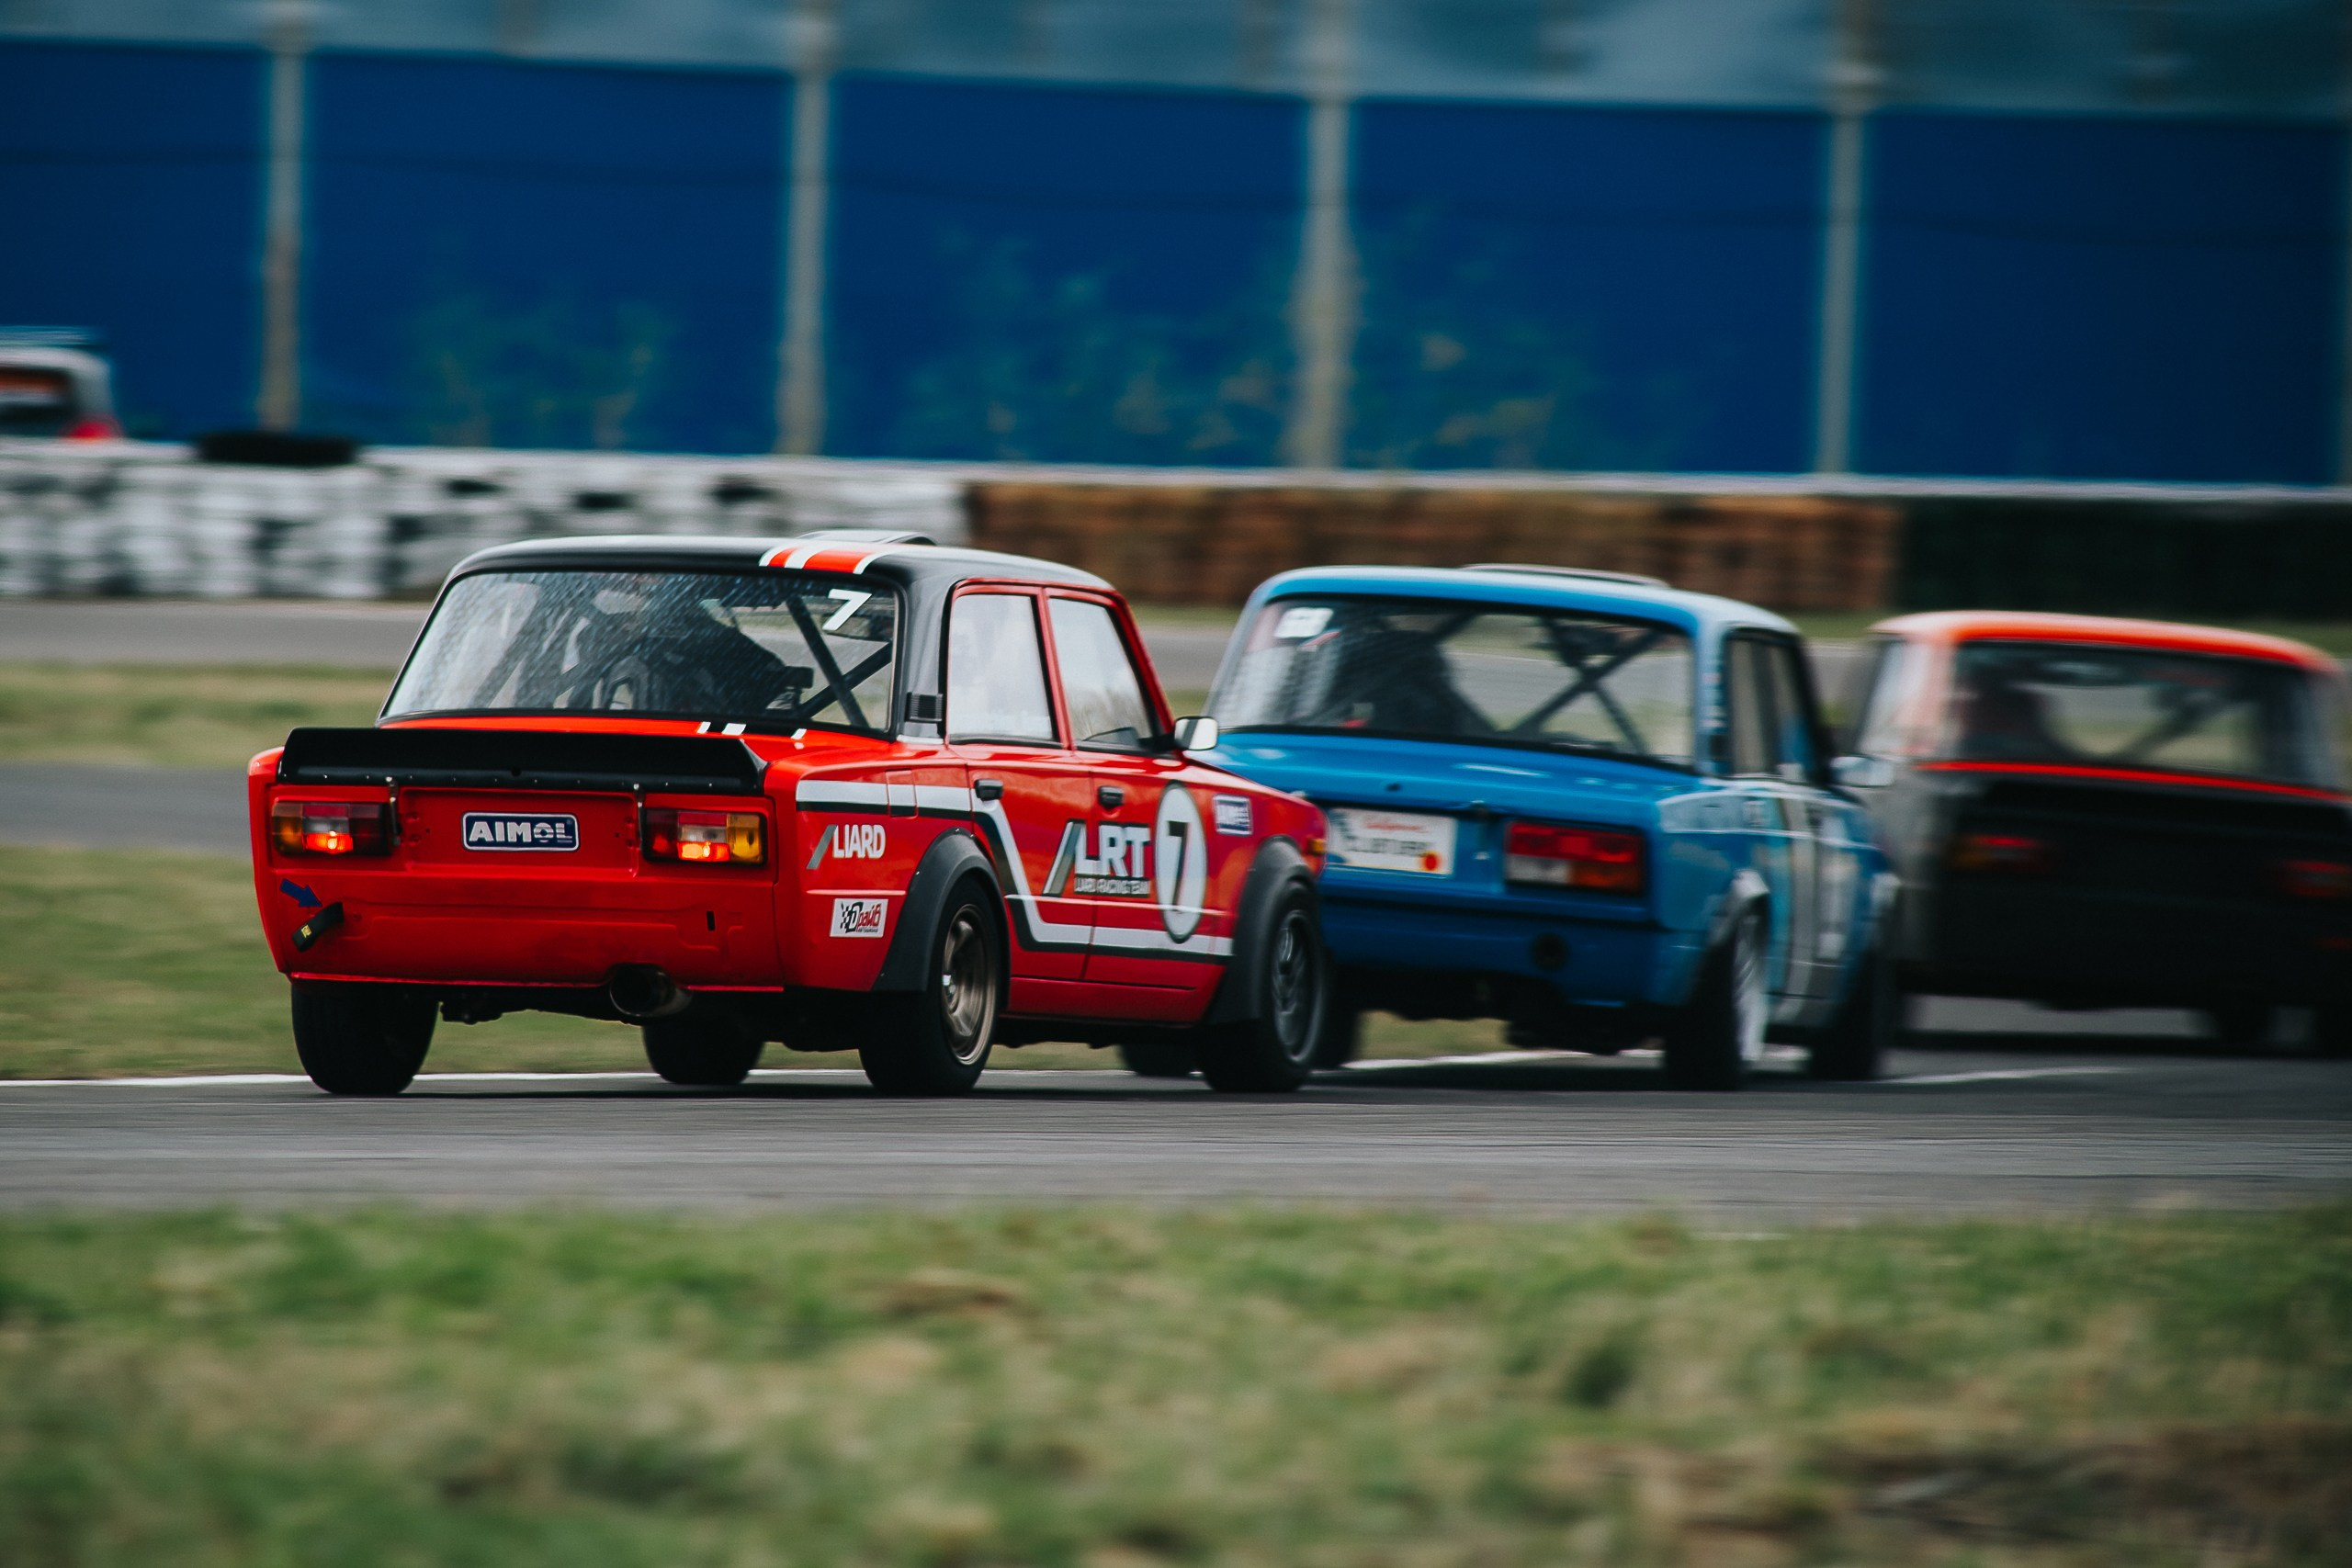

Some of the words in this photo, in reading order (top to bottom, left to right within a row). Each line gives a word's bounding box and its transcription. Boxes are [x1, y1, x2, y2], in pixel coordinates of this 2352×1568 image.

[821, 588, 873, 632] 7
[469, 820, 573, 843] AIMOL
[832, 823, 887, 860] LIARD
[1073, 823, 1151, 879] LRT
[1167, 819, 1190, 913] 7
